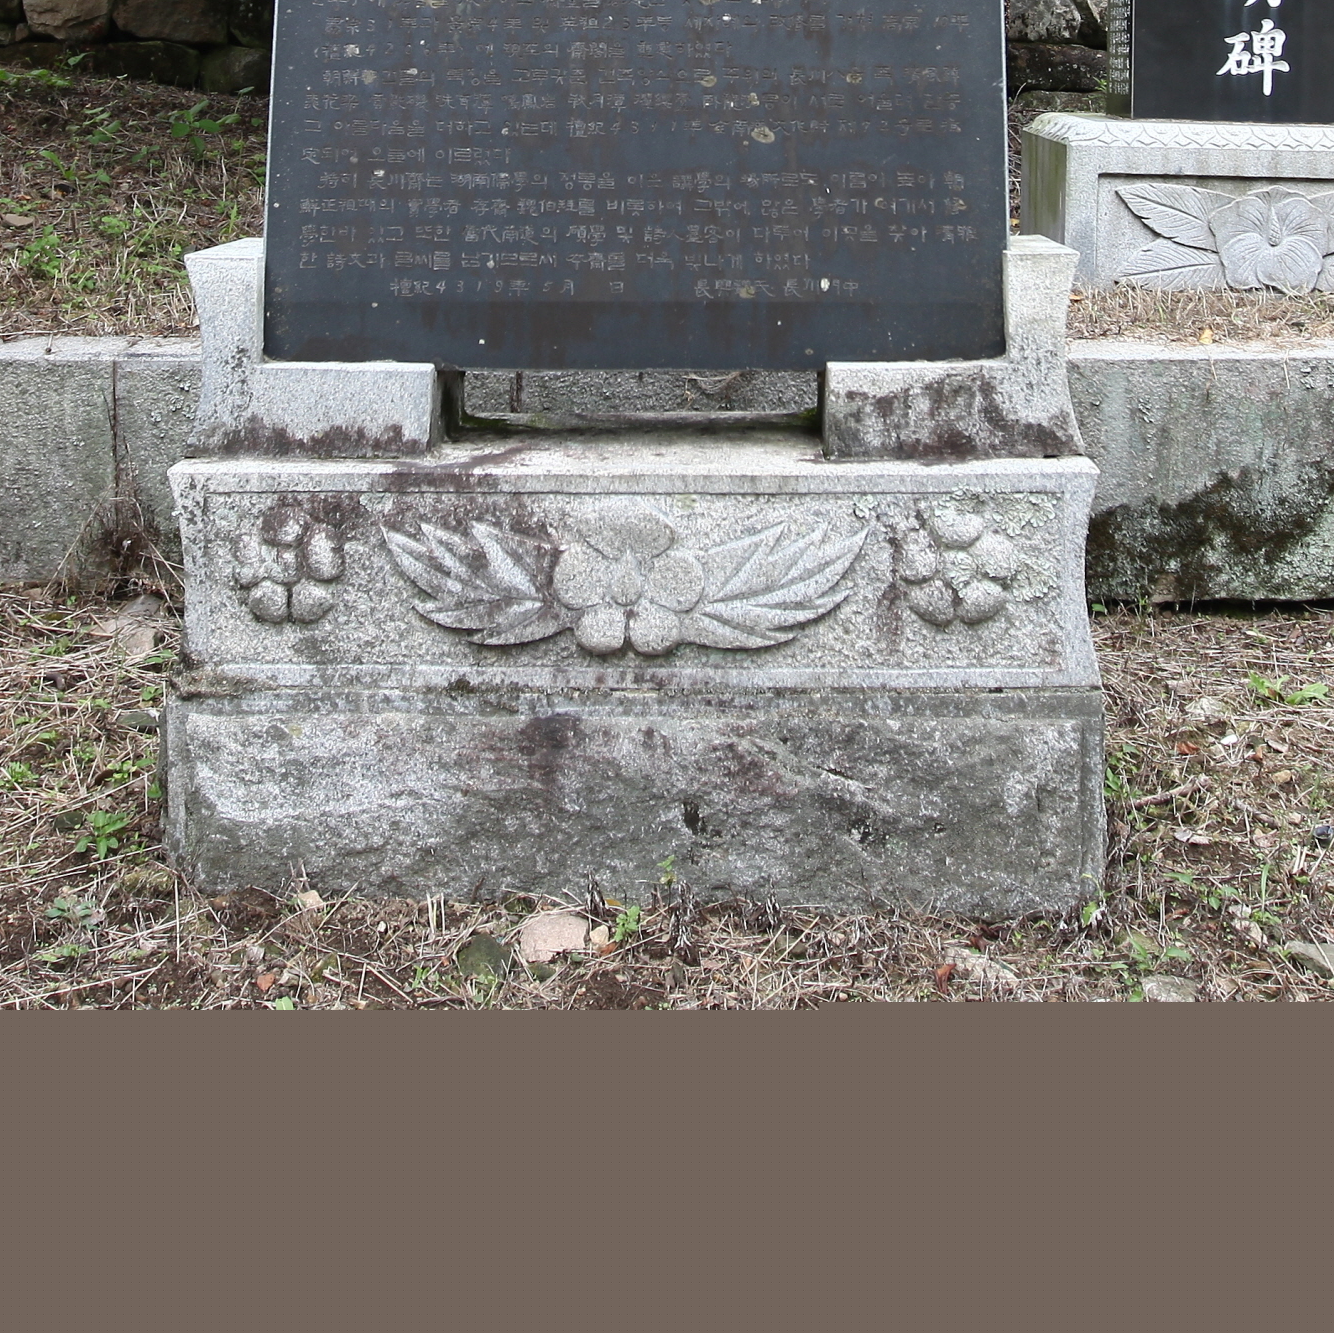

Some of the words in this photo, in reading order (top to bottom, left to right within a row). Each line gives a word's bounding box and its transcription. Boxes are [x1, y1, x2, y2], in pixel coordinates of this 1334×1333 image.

[367, 146, 426, 165] 오늘에
[606, 198, 683, 217] 비롯하여
[414, 224, 451, 246] 또한
[615, 224, 634, 246] 및
[298, 251, 318, 271] 한
[752, 251, 812, 271] 하였다
[610, 278, 626, 298] 日
